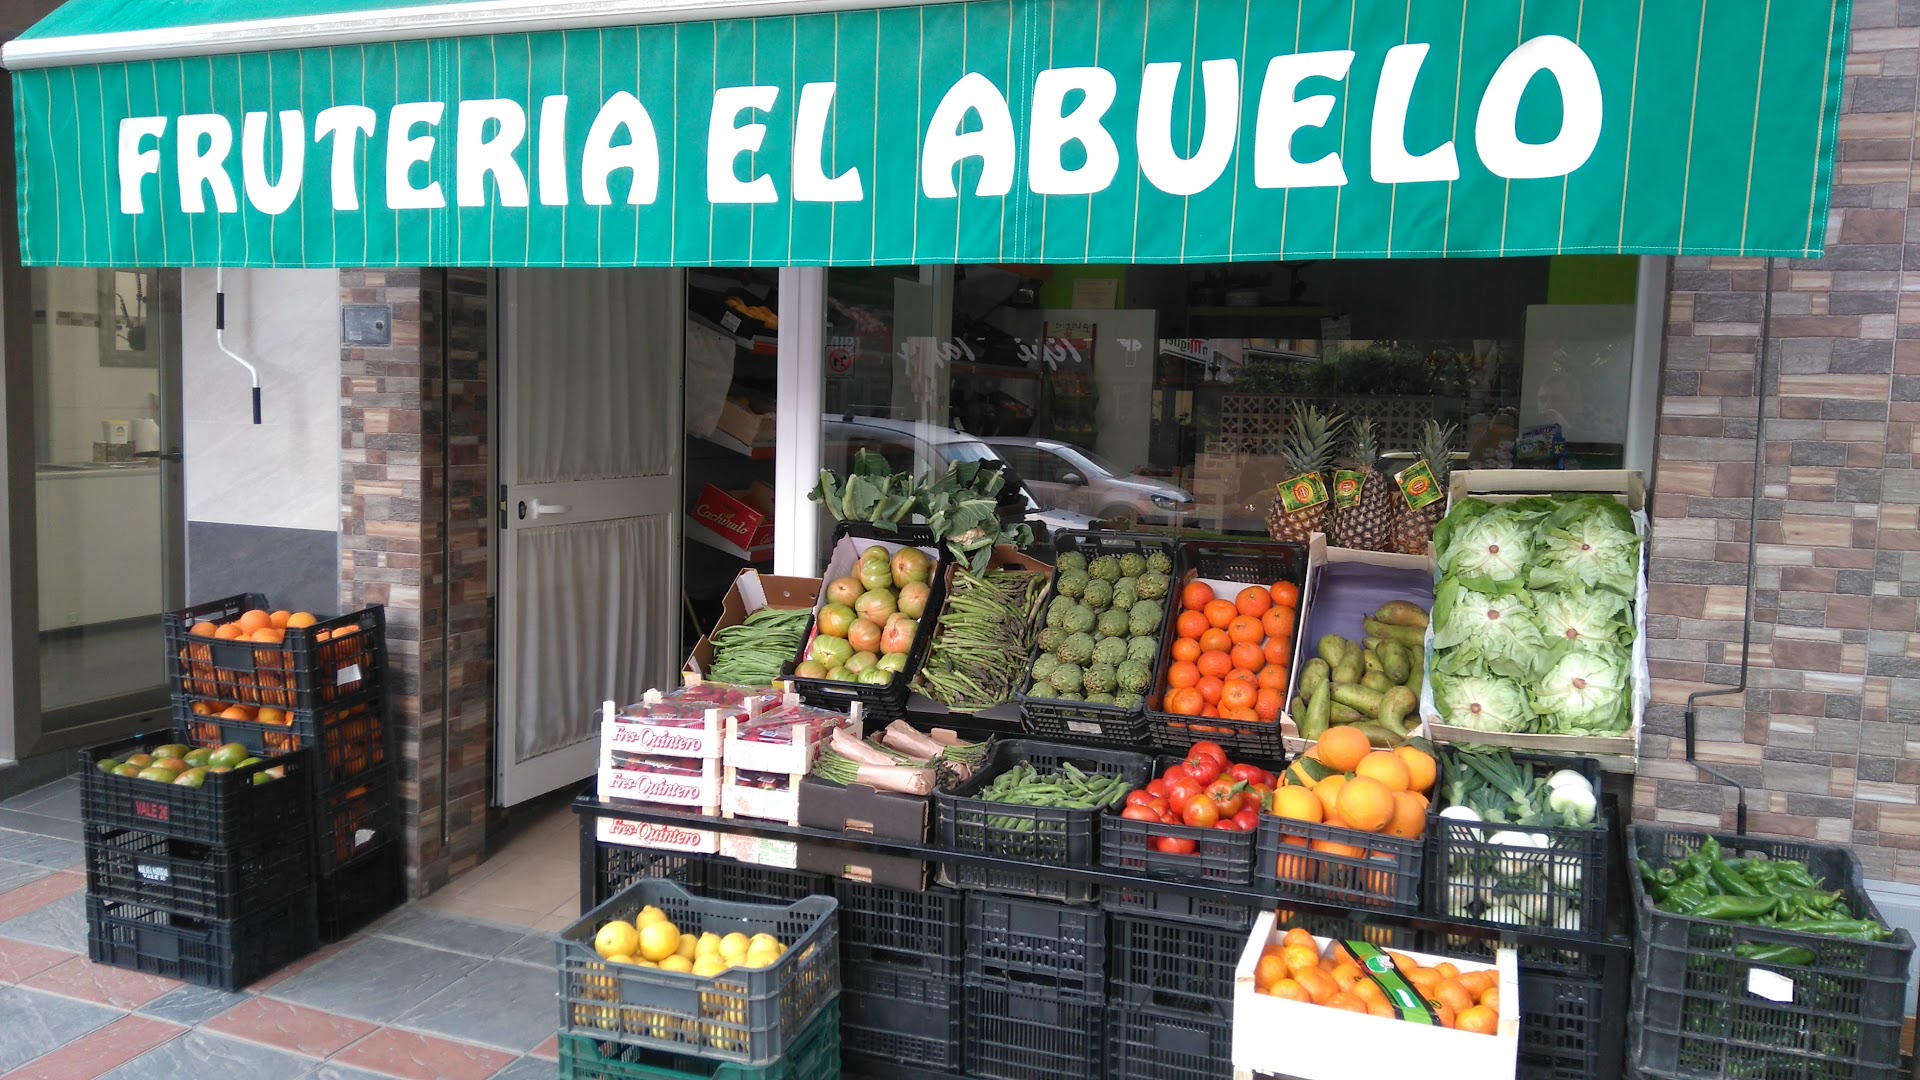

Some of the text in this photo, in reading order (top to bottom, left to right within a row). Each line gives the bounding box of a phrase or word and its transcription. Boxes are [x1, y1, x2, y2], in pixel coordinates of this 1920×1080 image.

[118, 34, 1603, 216] FRUTERIA EL ABUELO
[696, 503, 750, 535] Cachirulo
